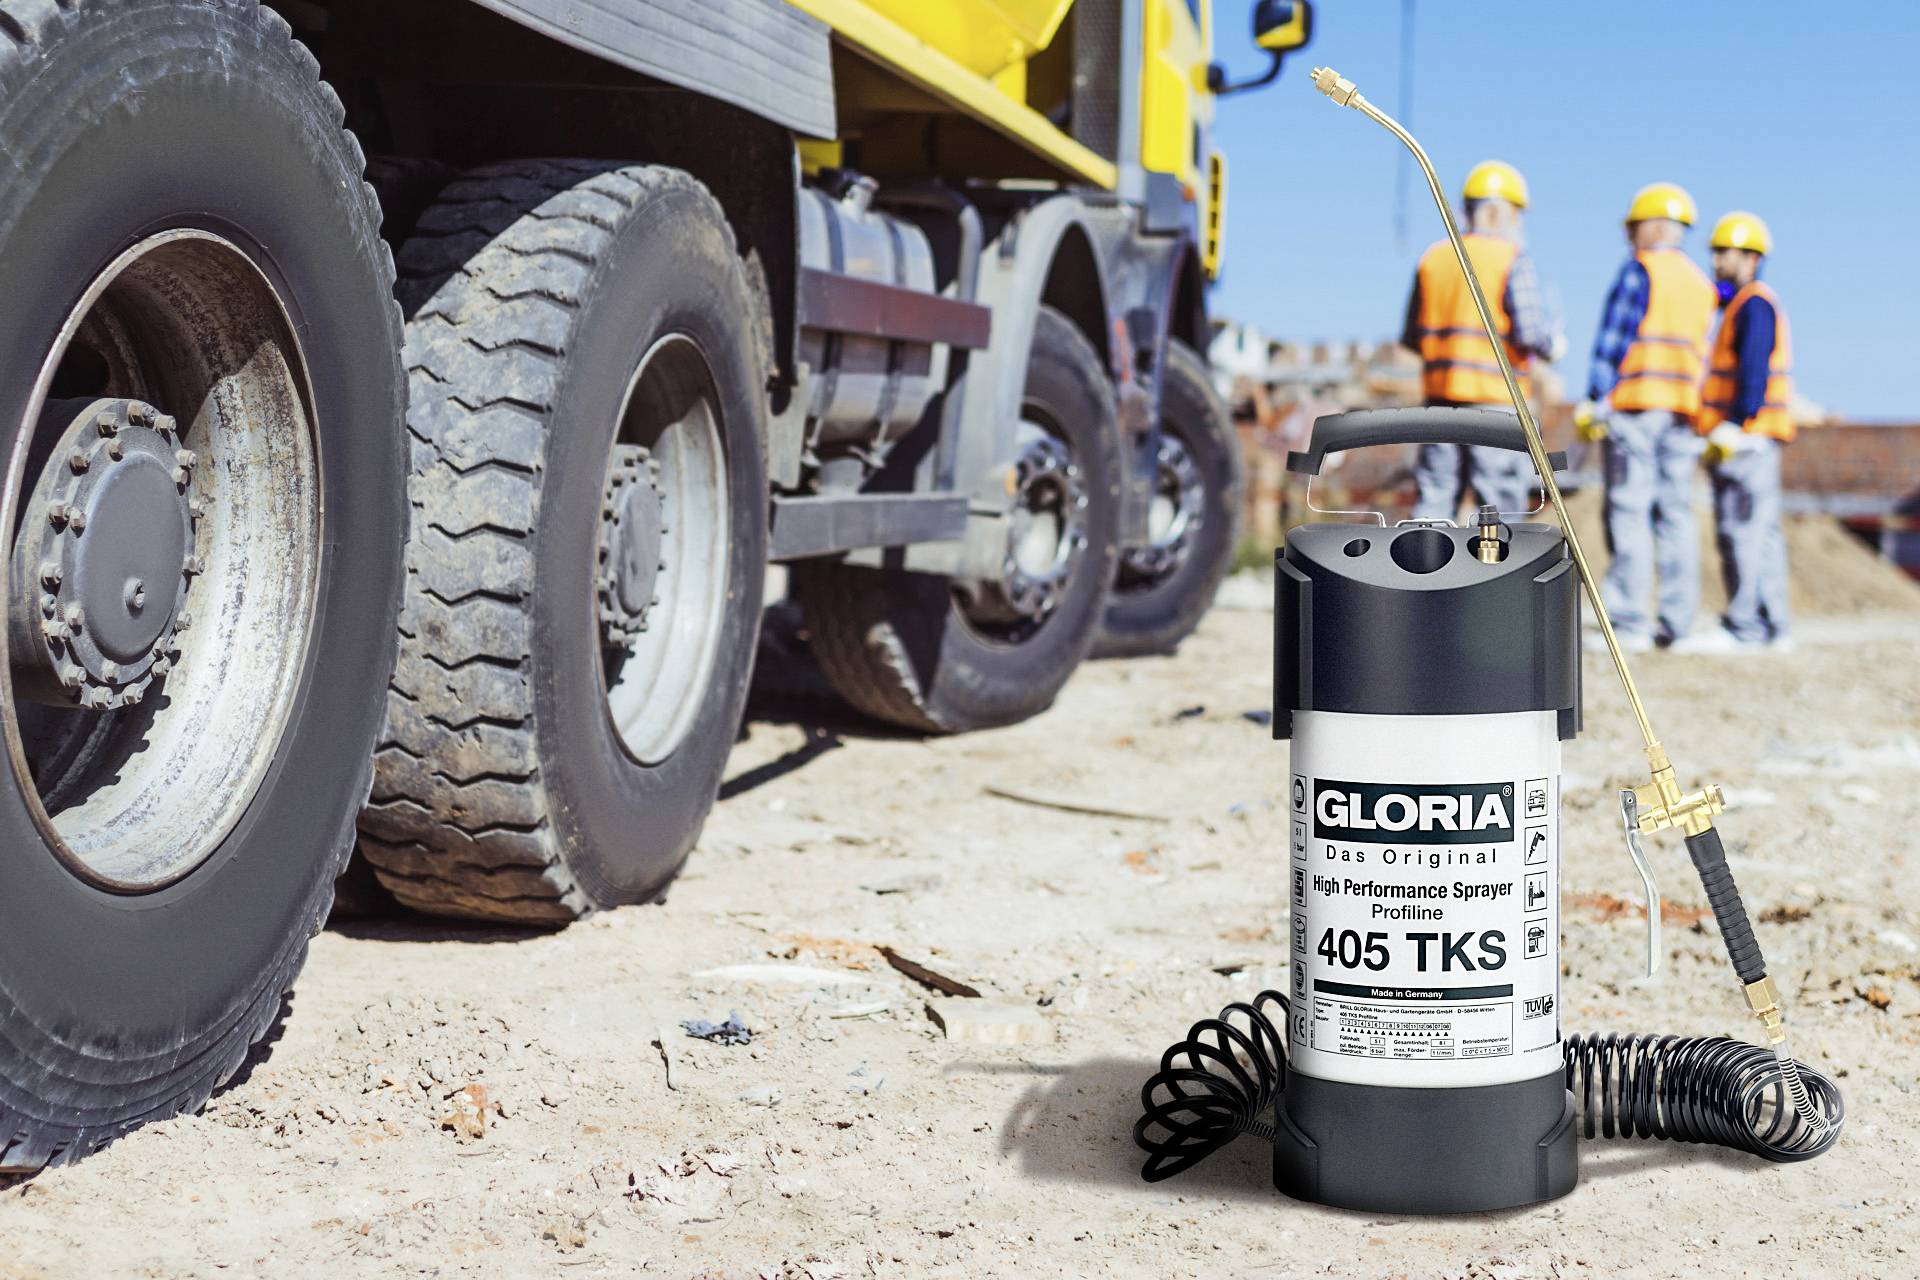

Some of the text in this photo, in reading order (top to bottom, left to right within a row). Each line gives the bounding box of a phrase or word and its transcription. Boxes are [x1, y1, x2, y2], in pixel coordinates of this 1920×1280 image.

[1326, 844, 1365, 862] Das
[1383, 848, 1496, 868] Original
[1314, 874, 1513, 901] High Performance Sprayer
[1372, 904, 1443, 920] Profiline
[1318, 928, 1507, 972] 405 TKS
[1371, 988, 1443, 999] Made in Germany
[1524, 999, 1542, 1013] TÜV
